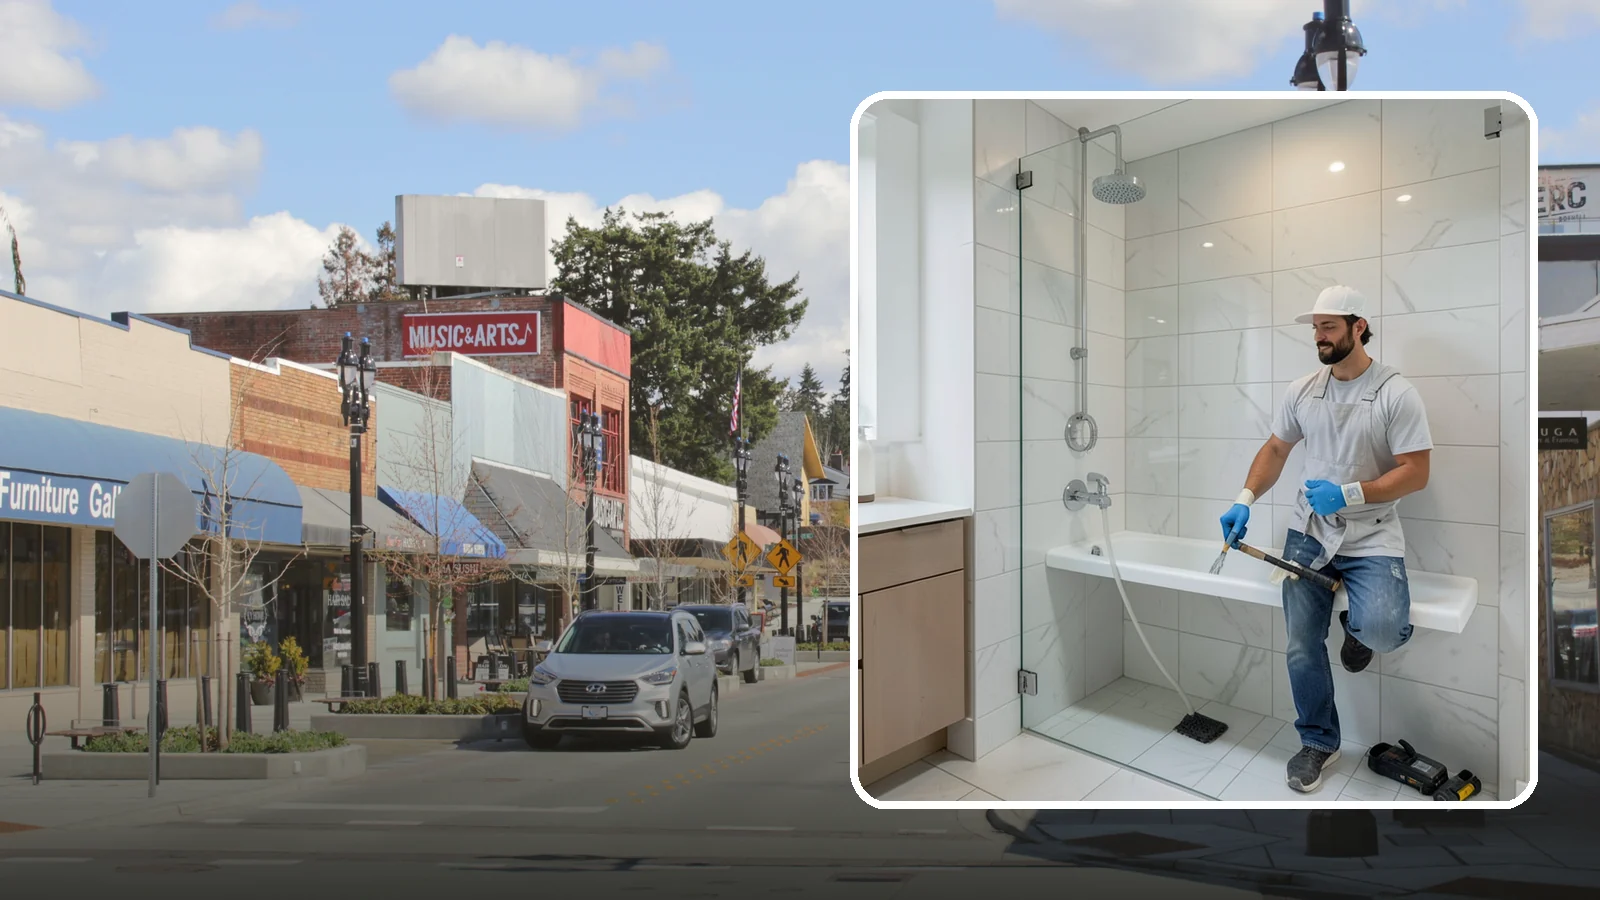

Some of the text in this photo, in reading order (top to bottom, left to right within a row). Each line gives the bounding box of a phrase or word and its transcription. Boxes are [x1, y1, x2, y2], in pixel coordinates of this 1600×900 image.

[408, 322, 520, 349] MUSIC&ARTS
[1540, 427, 1577, 436] UGA
[0, 471, 122, 519] Furniture Gal
